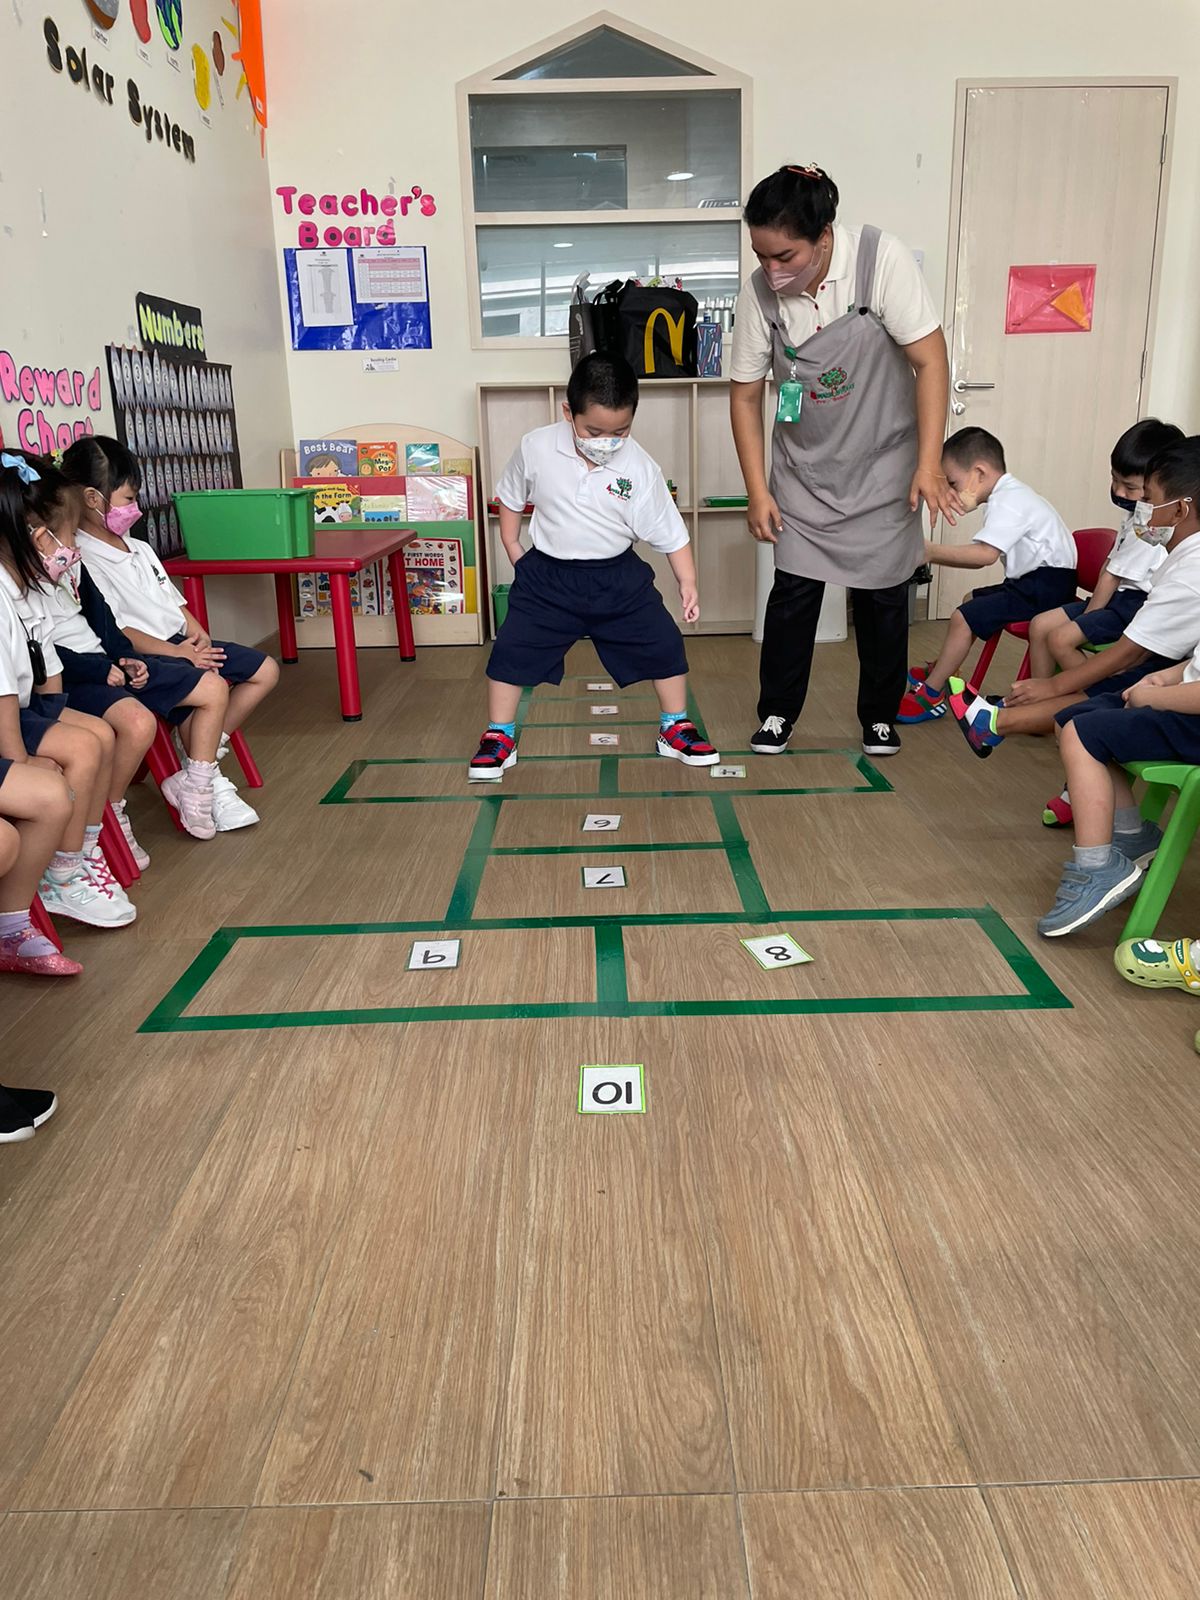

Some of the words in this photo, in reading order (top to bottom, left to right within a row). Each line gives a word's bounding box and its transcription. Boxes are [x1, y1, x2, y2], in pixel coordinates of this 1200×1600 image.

[44, 17, 114, 106] Solar
[127, 78, 195, 163] System
[276, 186, 437, 217] Teacher's
[298, 218, 396, 249] Board
[139, 303, 204, 352] Numbers
[0, 350, 101, 411] Reward
[304, 442, 328, 455] Best
[329, 442, 354, 454] Bear
[414, 558, 444, 567] HOME
[765, 946, 792, 961] 8
[592, 1081, 633, 1105] 10
